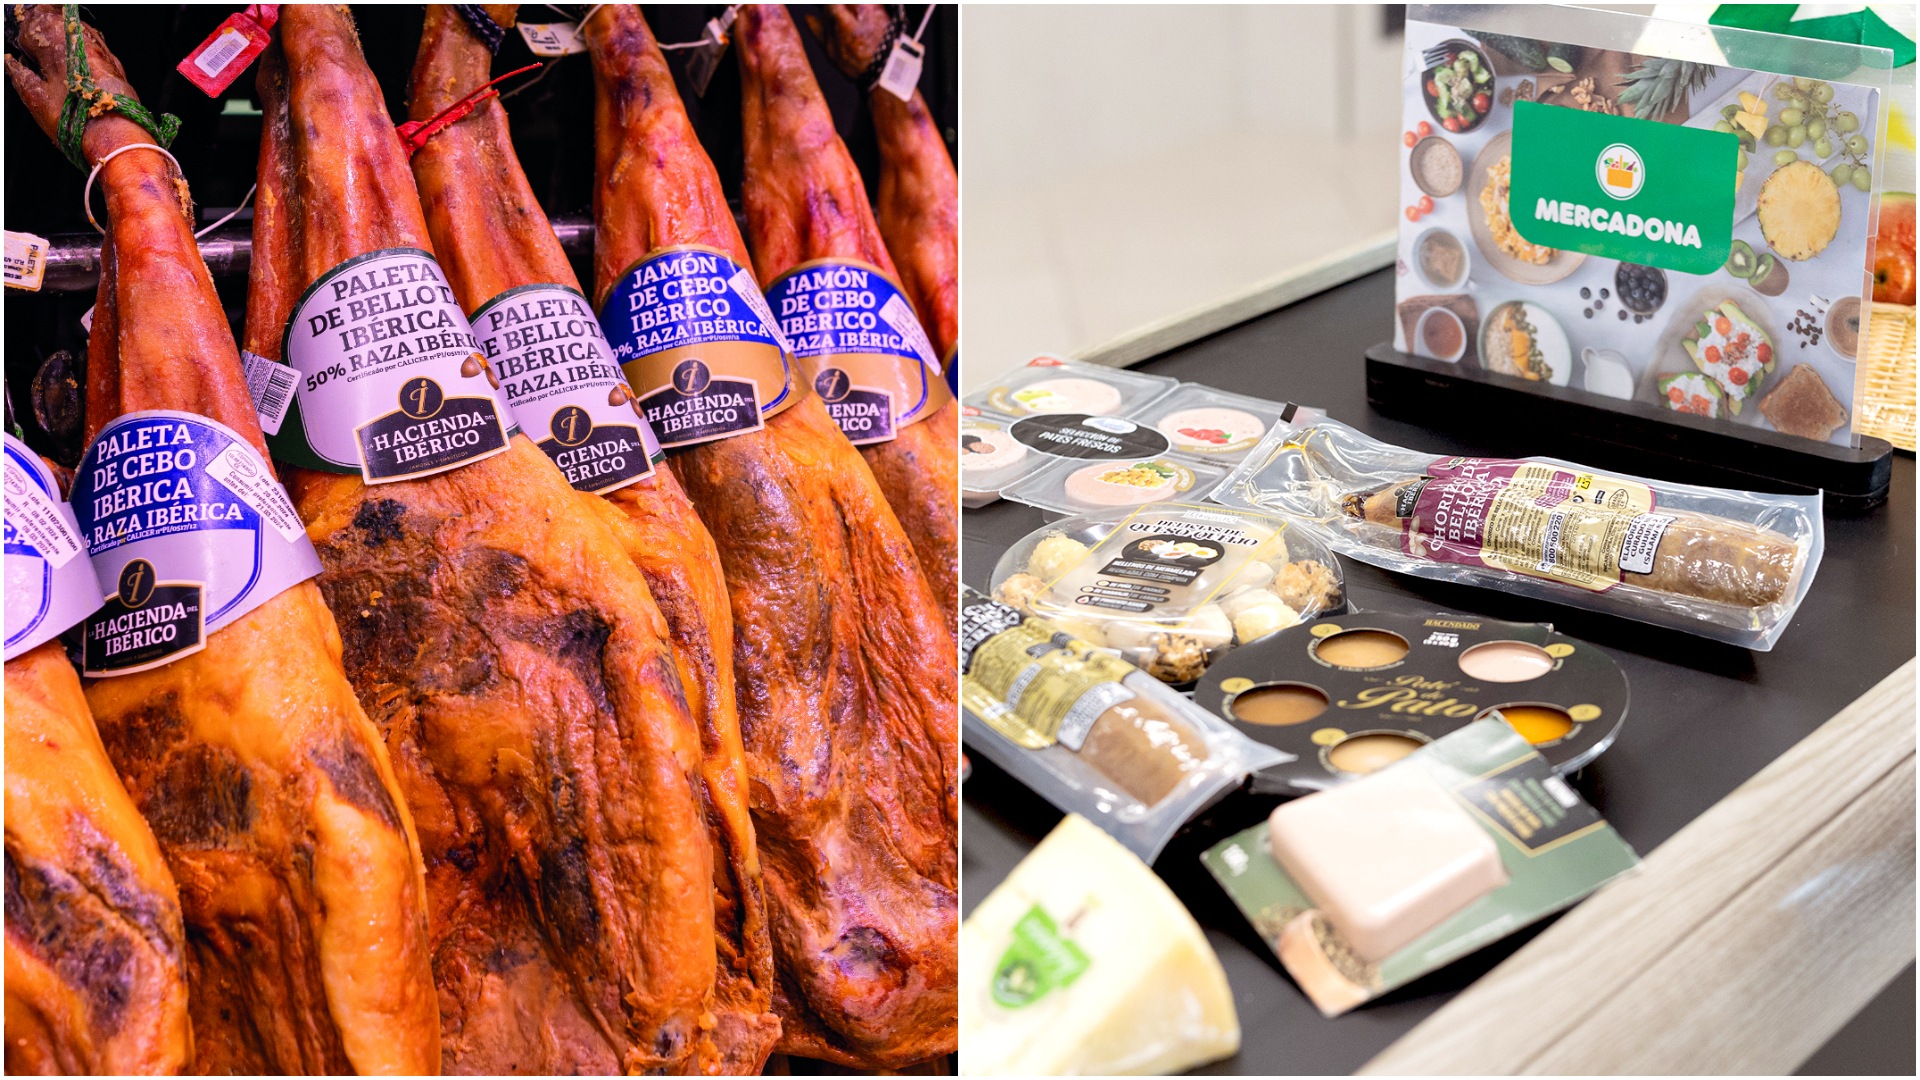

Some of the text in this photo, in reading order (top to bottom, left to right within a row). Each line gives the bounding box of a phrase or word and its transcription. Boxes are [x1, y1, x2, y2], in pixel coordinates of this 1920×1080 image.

[1534, 197, 1702, 249] MERCADONA
[26, 244, 38, 274] PALETA
[632, 253, 717, 289] JAMÓN
[331, 263, 440, 302] PALETA
[628, 276, 728, 312] DE CEBO
[786, 266, 868, 295] JAMÓN
[488, 299, 587, 332] PALETA
[630, 298, 731, 334] IBÉRICO
[781, 290, 876, 316] DE CEBO
[308, 307, 344, 338] DE
[339, 309, 456, 352] IBÉRICA
[636, 325, 690, 351] RAZA
[694, 316, 770, 338] IBÉRICA
[781, 310, 876, 336] IBÉRICO
[632, 346, 662, 360] Certificado
[663, 342, 674, 352] por
[674, 336, 702, 348] CALICER
[786, 327, 914, 352] RAZA IBÉRICA
[306, 363, 346, 392] 50%
[349, 341, 414, 372] RAZA
[347, 366, 383, 382] Certificado
[384, 364, 396, 374] por
[397, 355, 428, 368] CALICER
[495, 342, 604, 380] IBÉRICA
[504, 372, 568, 400] RAZA
[510, 395, 536, 408] rtificado
[538, 392, 548, 402] por
[549, 384, 579, 396] CALICER
[647, 393, 745, 422] HACIENDA
[663, 408, 738, 434] IBÉRICO
[825, 402, 880, 418] IENDA
[96, 424, 194, 464] PALETA
[373, 412, 487, 452] HACIENDA
[394, 430, 480, 464] IBÉRICO
[1071, 438, 1122, 453] FRESCOS
[552, 438, 632, 468] CIENDA
[94, 462, 118, 492] DE
[122, 449, 196, 479] CEBO
[224, 477, 238, 489] antes
[229, 470, 254, 492] Consumir
[561, 456, 626, 484] ÉRICO
[28, 492, 42, 507] Lote:
[94, 477, 194, 521] IBÉRICA
[1430, 459, 1482, 552] CHORIZO DE
[1448, 472, 1490, 542] BELLOA
[1464, 479, 1502, 540] IBÉRICO
[20, 513, 60, 554] preferentemente
[31, 511, 58, 540] 08.02.2024
[94, 514, 142, 546] RAZA
[146, 501, 244, 528] IBÉRICA
[1554, 514, 1563, 530] 220
[22, 525, 50, 554] 09.03.2024
[90, 539, 117, 554] Certificado
[126, 529, 154, 542] CALICER
[1630, 522, 1647, 558] CURADO
[1155, 566, 1198, 578] MERMELADA
[95, 602, 187, 640] HACIENDA
[1423, 619, 1482, 630] HACENDADO
[106, 624, 176, 656] IBÉRICO
[1337, 686, 1478, 718] Pato
